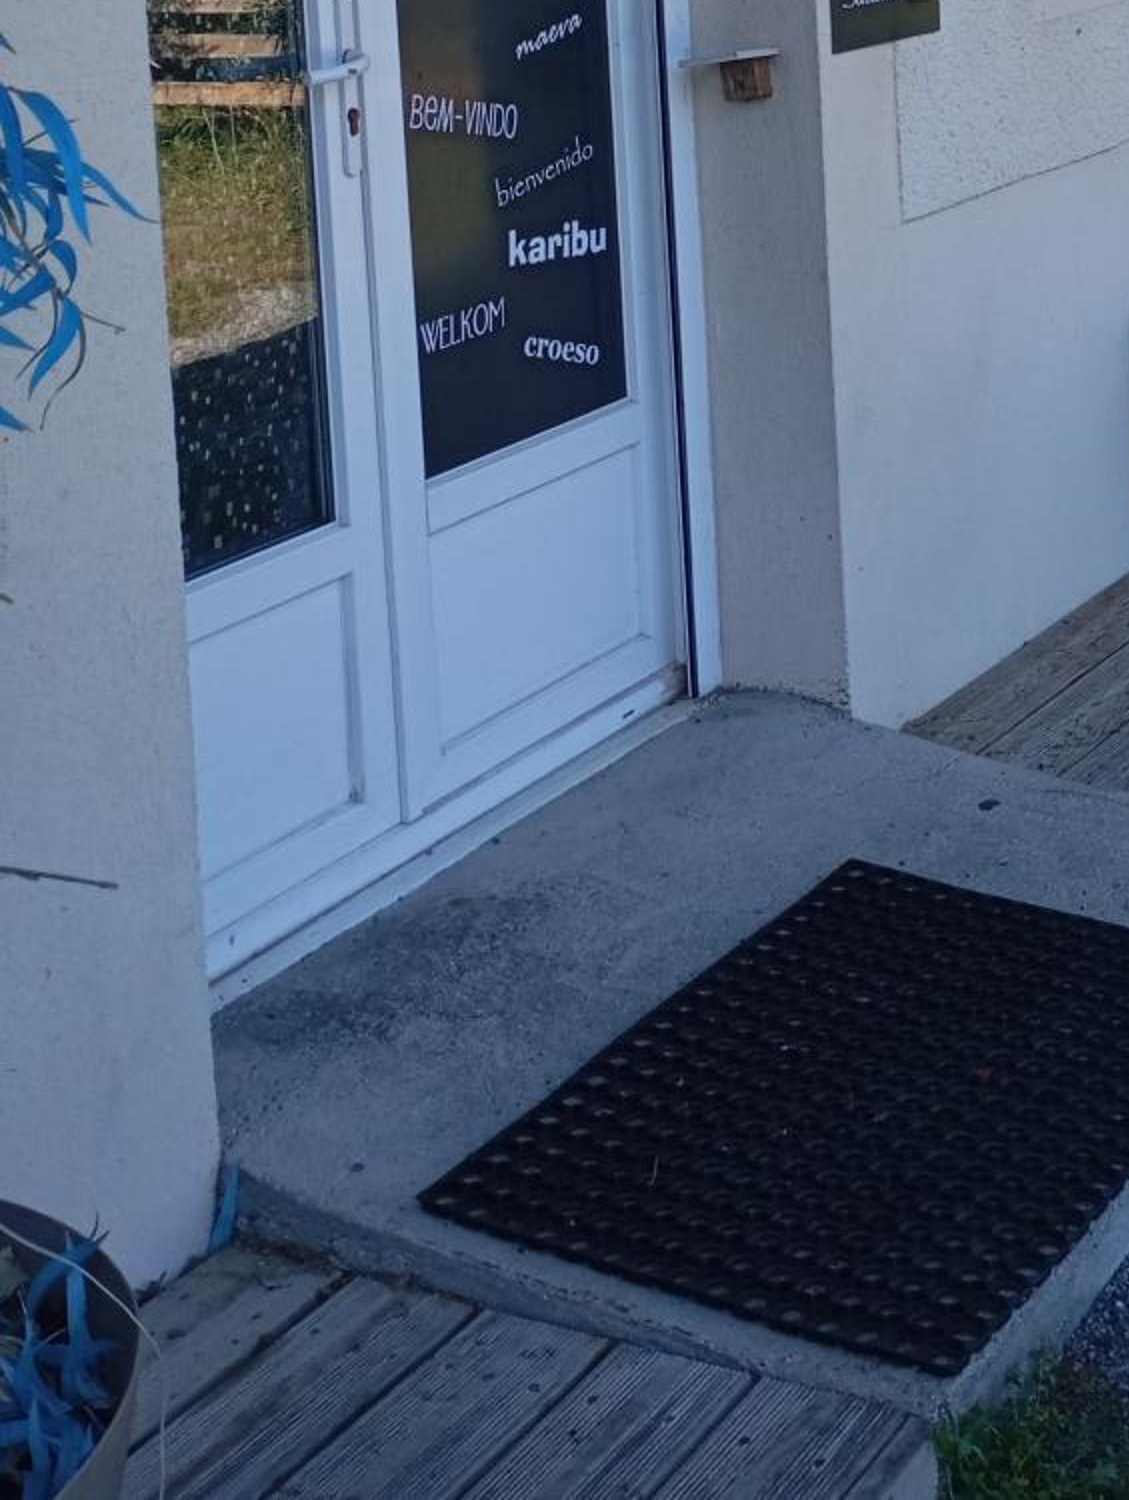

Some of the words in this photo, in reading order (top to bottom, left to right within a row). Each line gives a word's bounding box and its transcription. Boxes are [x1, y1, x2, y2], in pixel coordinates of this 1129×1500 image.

[515, 13, 582, 60] maeva
[495, 136, 593, 207] bienvenido
[509, 220, 606, 267] karibu
[420, 296, 505, 355] WELKOM
[524, 335, 599, 365] croeso
